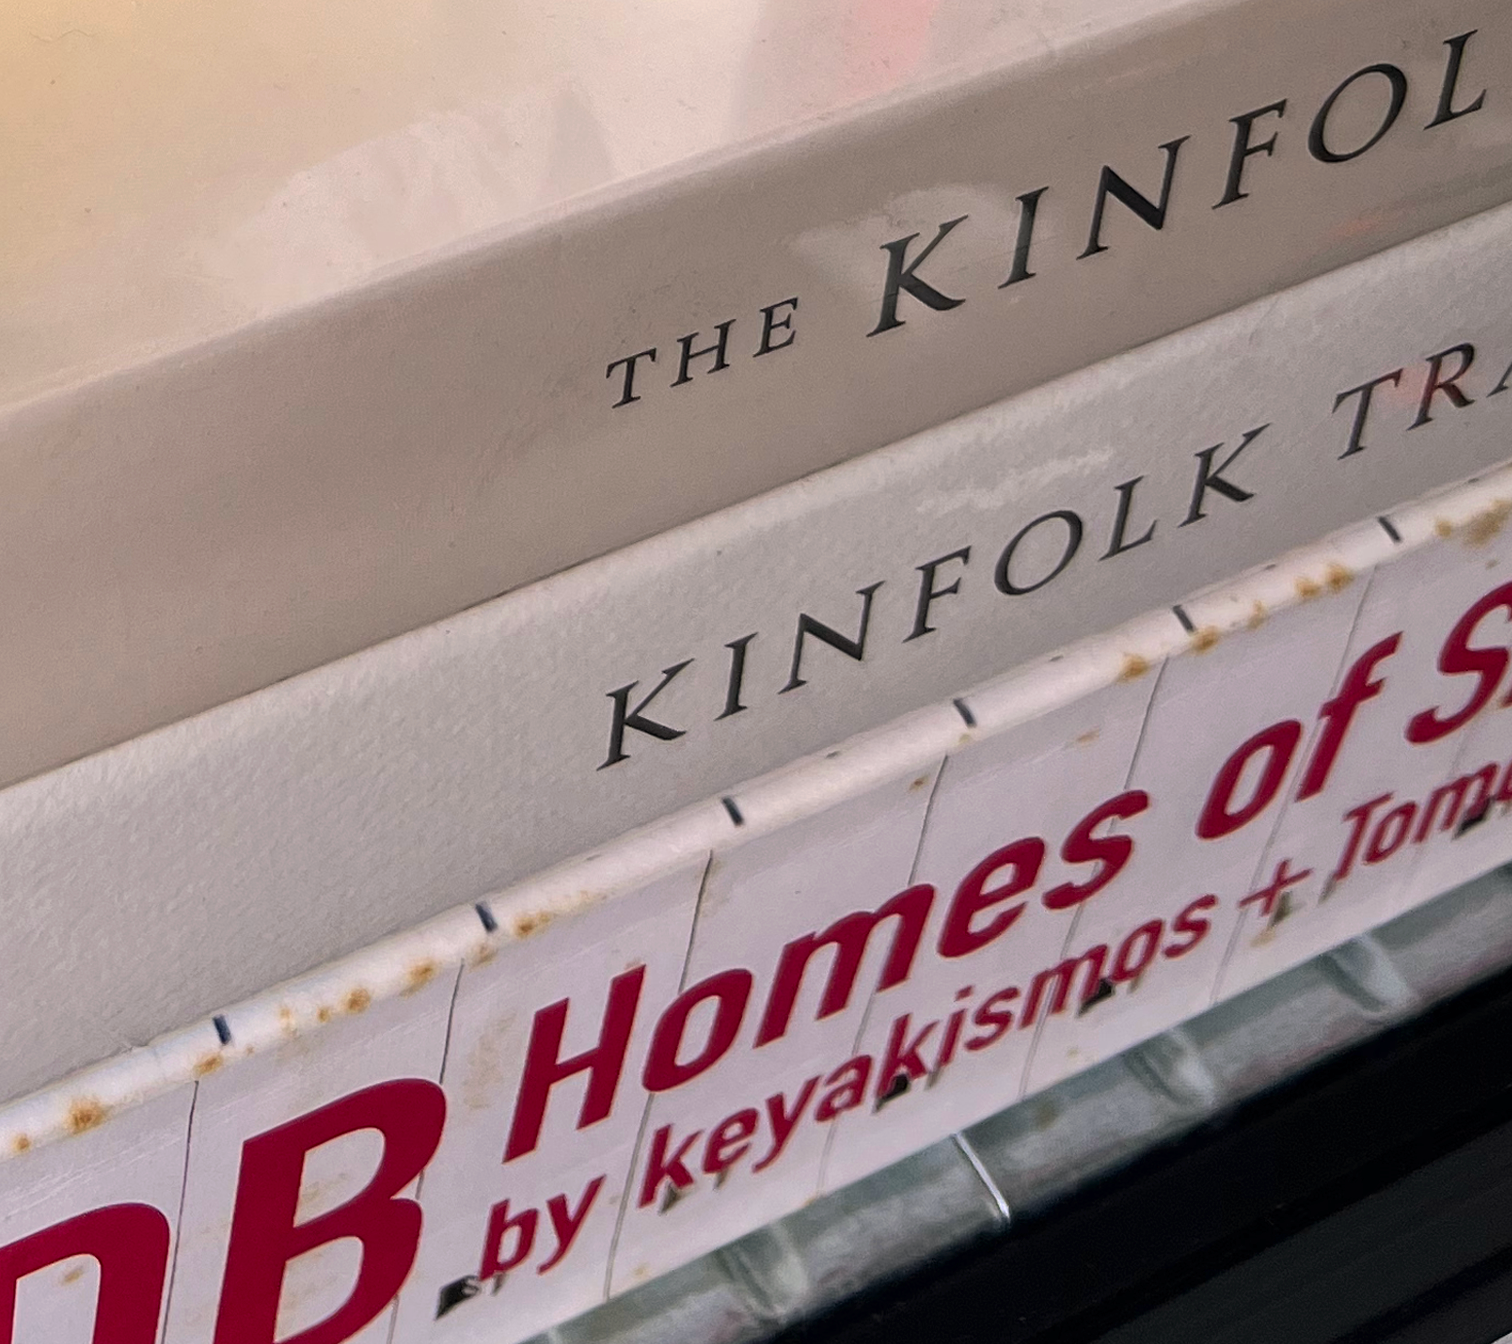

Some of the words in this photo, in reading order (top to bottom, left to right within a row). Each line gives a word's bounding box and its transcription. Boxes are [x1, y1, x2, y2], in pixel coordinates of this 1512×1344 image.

[605, 298, 800, 408] THE
[595, 423, 1273, 772] KINFOLK
[503, 788, 1151, 1164] Homes
[1195, 631, 1404, 840] of
[1405, 580, 1512, 745] S
[478, 1174, 606, 1281] by
[637, 893, 1217, 1210] keyakismos
[1237, 858, 1314, 917] +
